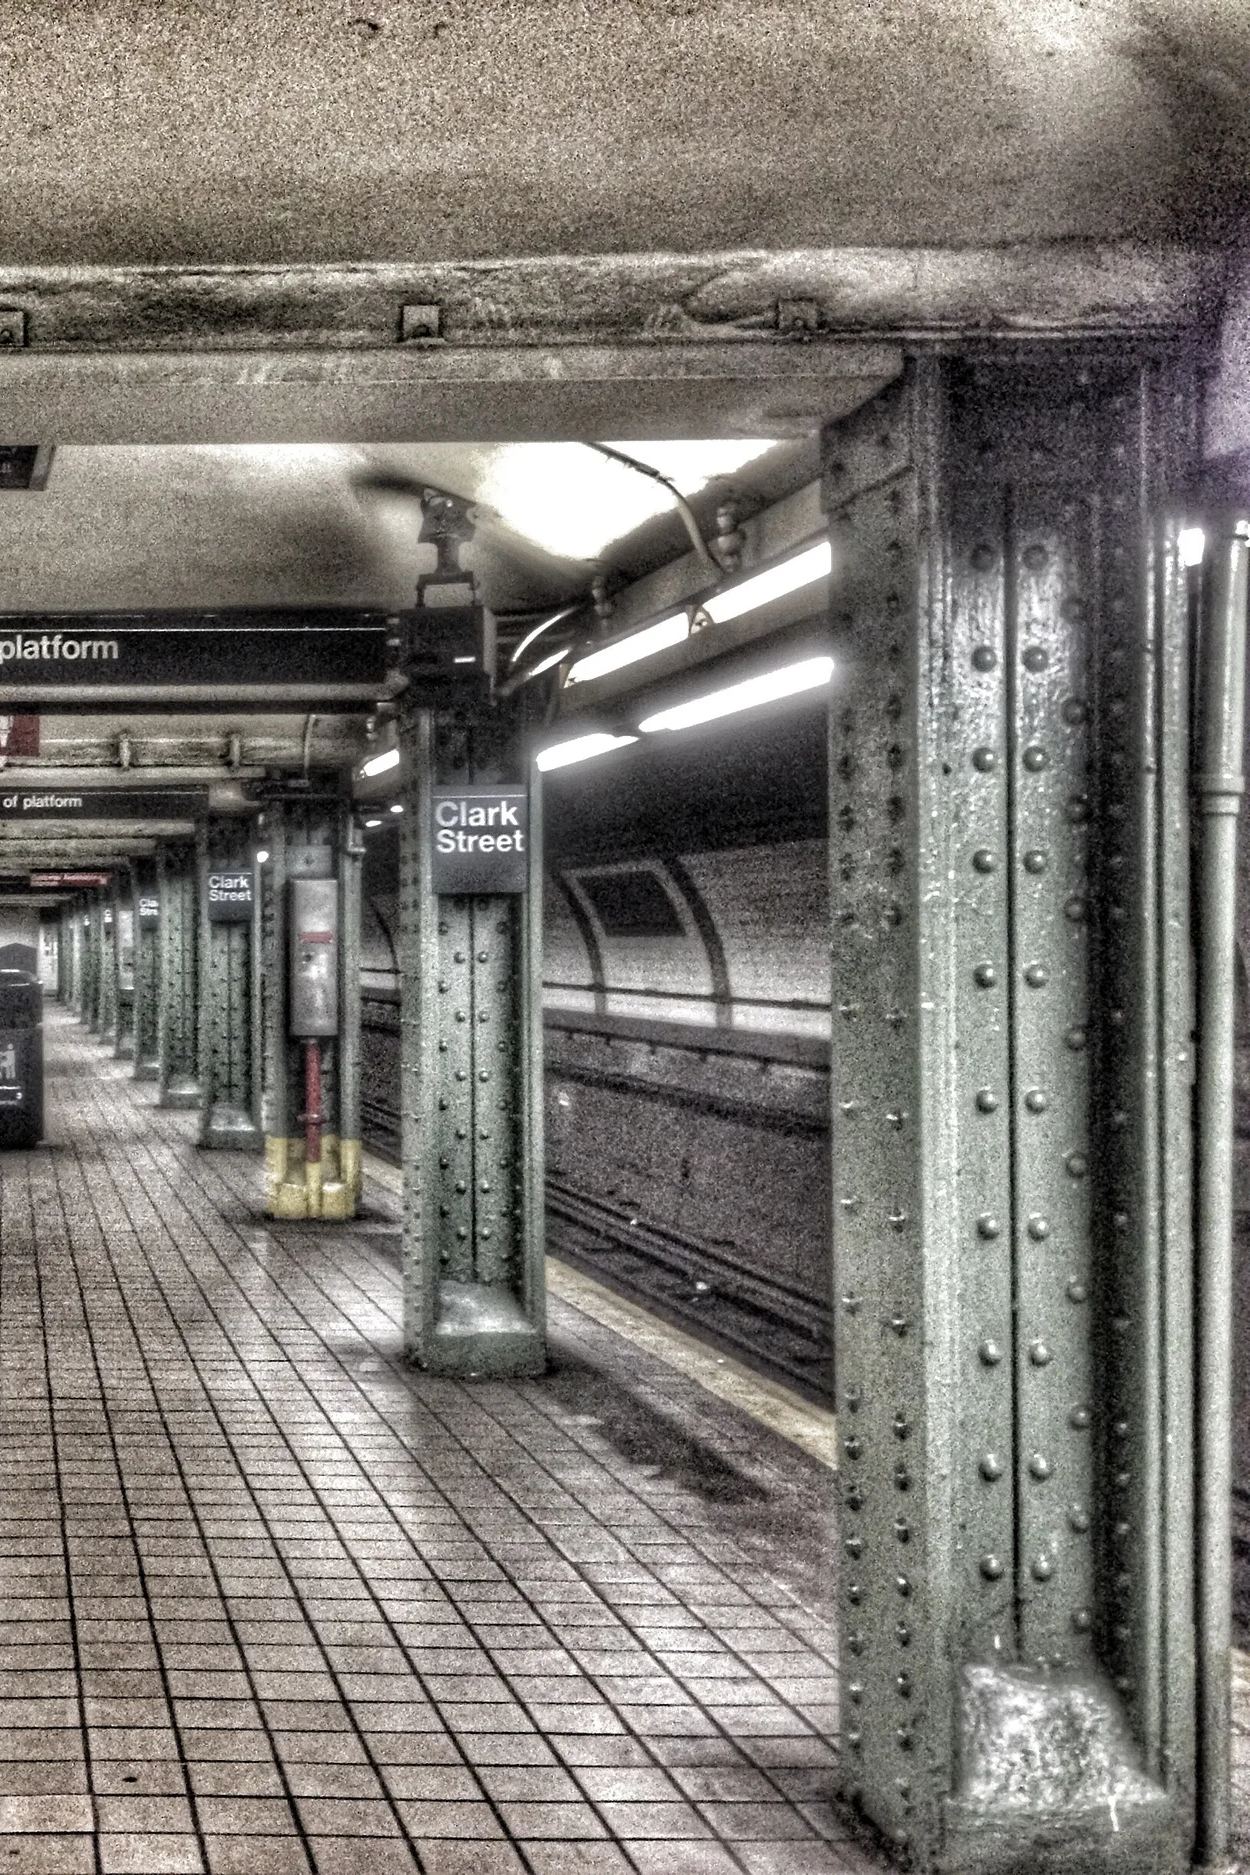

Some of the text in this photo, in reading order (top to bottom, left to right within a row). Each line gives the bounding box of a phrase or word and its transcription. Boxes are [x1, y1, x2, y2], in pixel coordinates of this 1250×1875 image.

[3, 795, 19, 808] of
[23, 795, 83, 811] platform
[435, 801, 519, 827] Clark
[436, 829, 525, 853] Street
[209, 875, 249, 889] Clark
[209, 889, 252, 902] Street
